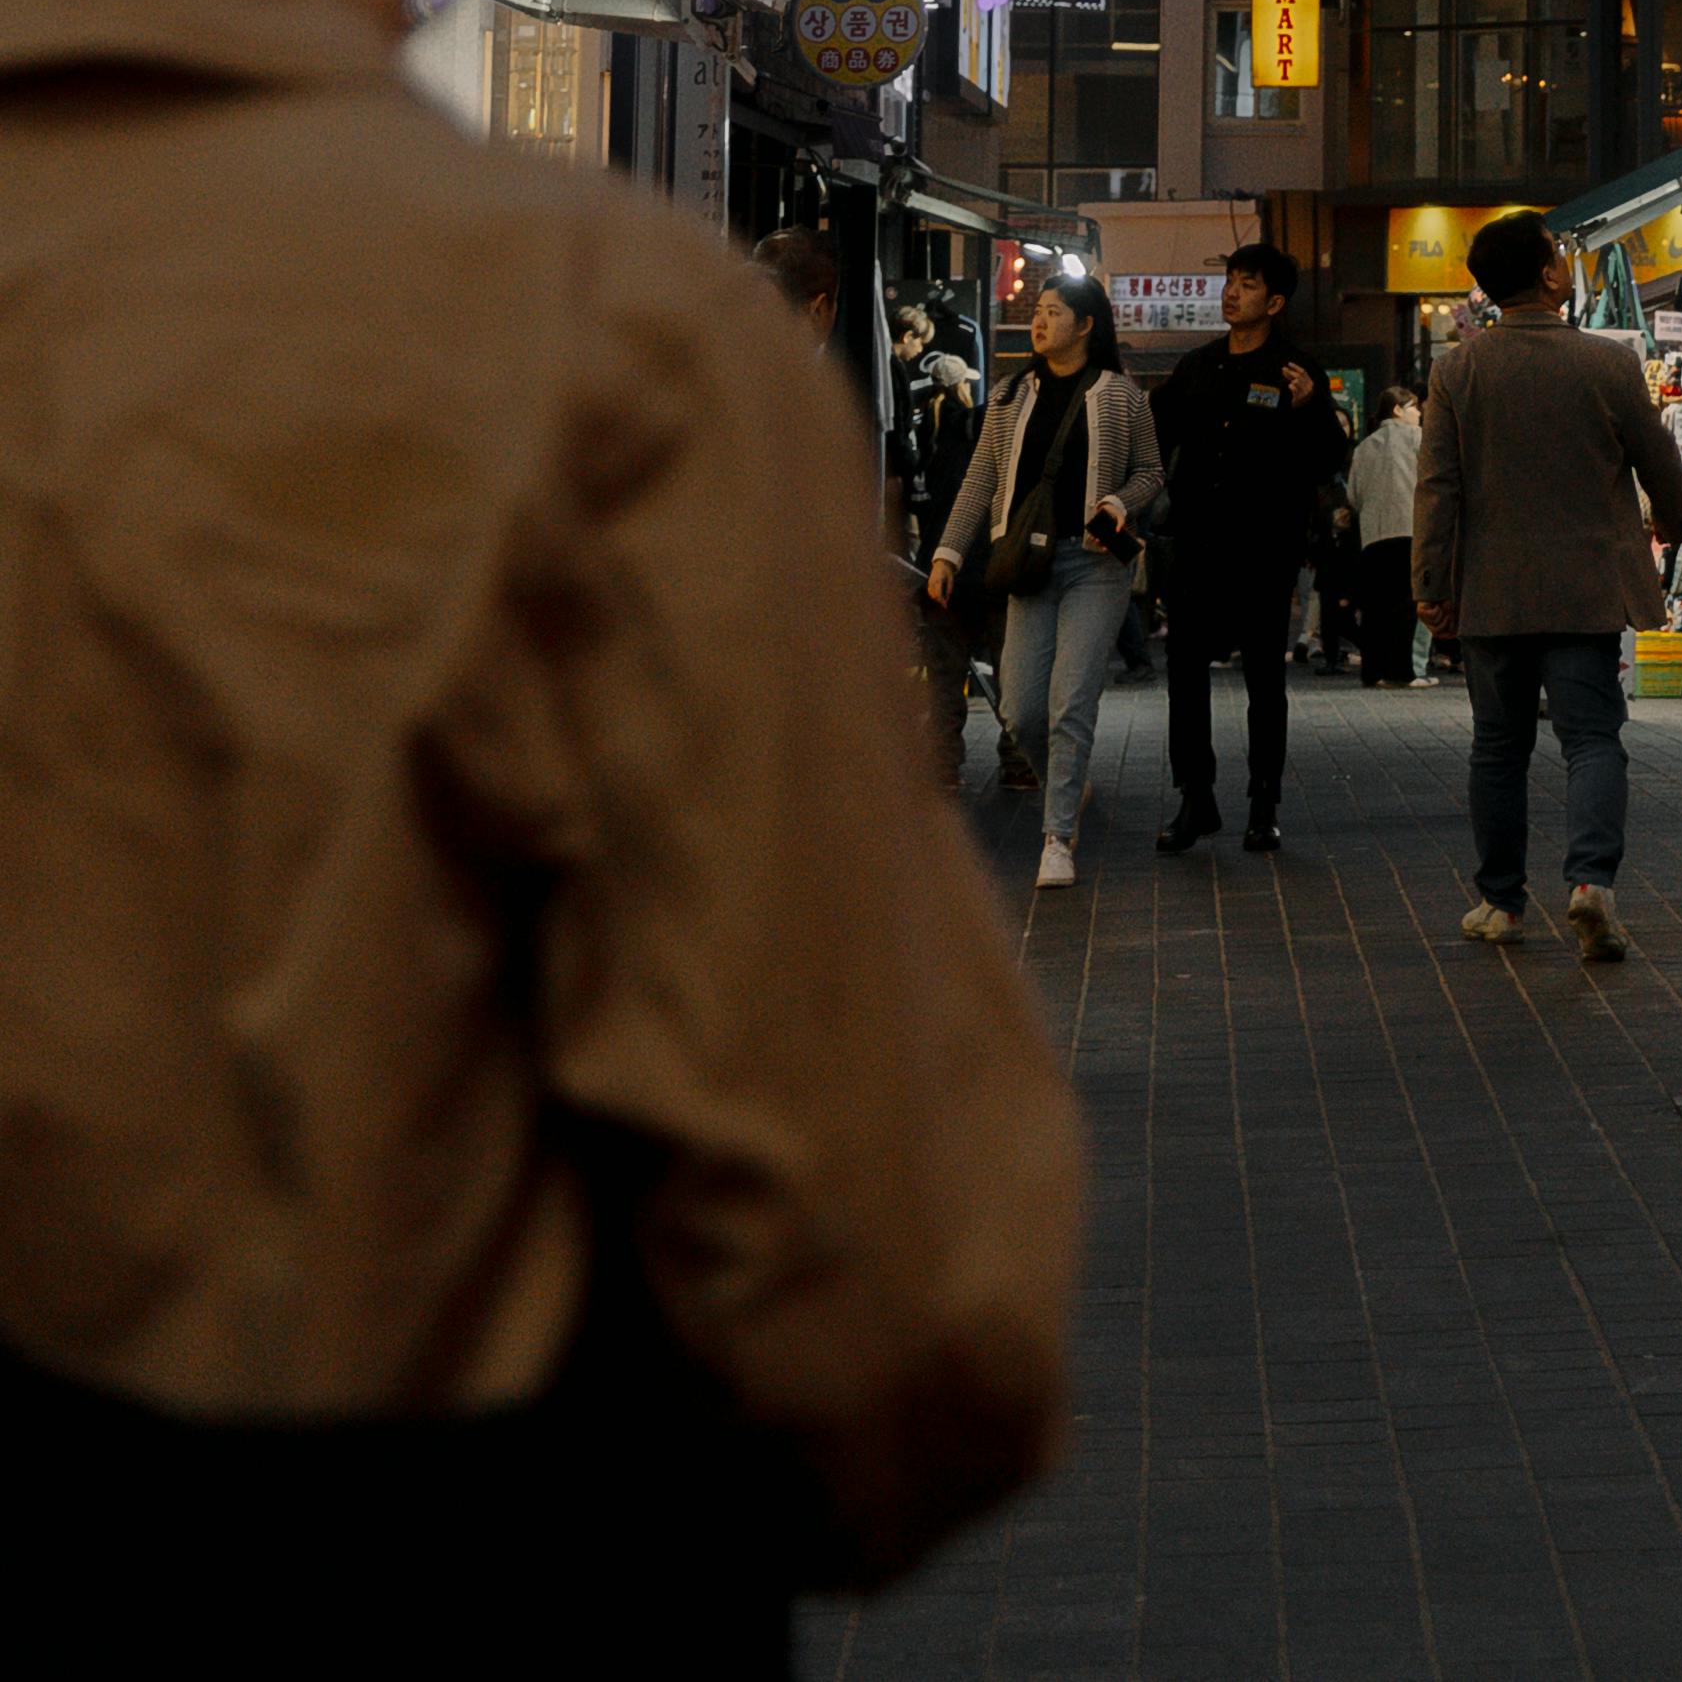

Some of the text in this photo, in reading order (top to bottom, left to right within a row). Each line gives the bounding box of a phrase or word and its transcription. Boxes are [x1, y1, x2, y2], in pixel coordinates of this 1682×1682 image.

[804, 10, 909, 39] 상품권
[820, 49, 900, 70] 商品券
[1409, 240, 1444, 258] FILA
